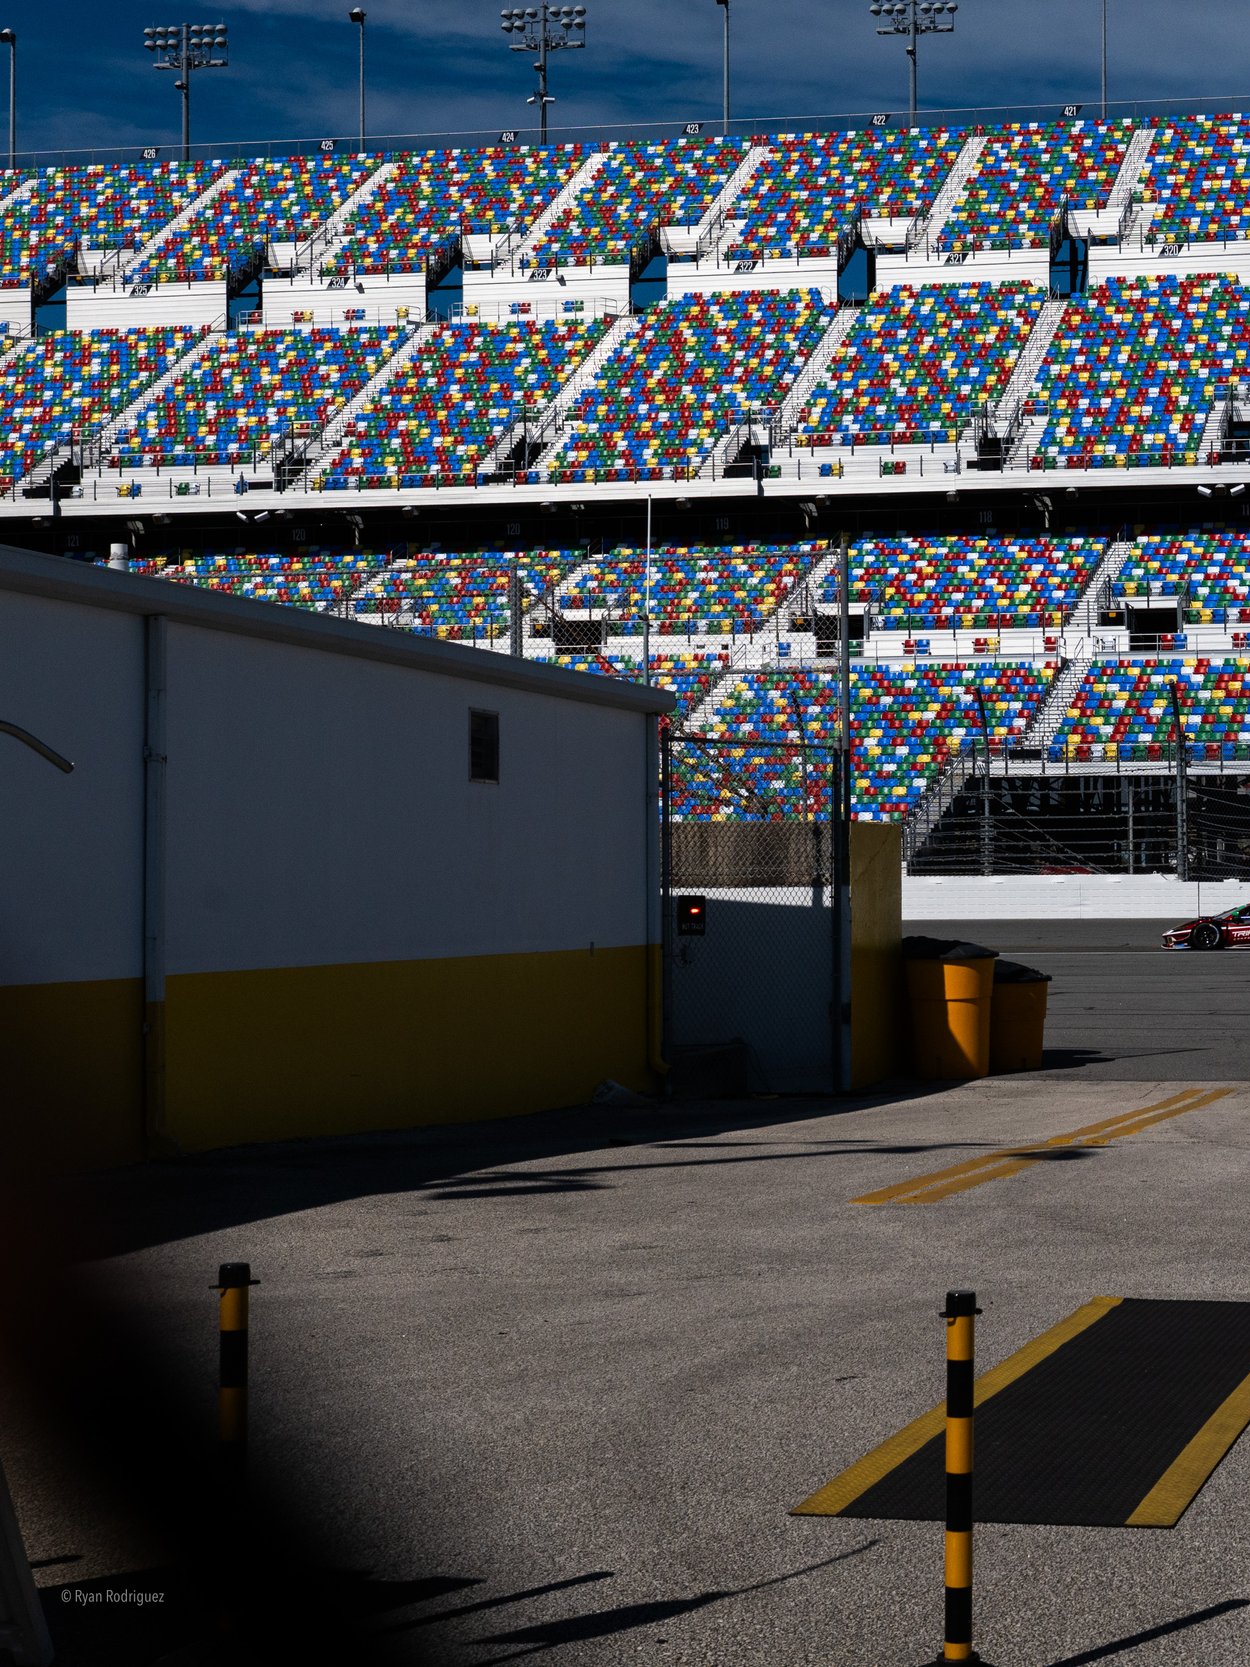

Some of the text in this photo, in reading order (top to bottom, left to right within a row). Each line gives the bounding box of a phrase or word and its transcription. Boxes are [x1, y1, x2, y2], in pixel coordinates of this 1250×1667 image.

[1064, 106, 1076, 116] 421
[873, 116, 885, 125] 422
[686, 124, 699, 134] 423
[502, 133, 514, 142] 424
[321, 141, 333, 150] 425
[143, 149, 156, 158] 426
[1164, 245, 1179, 255] 320
[949, 253, 963, 263] 321
[739, 262, 753, 272] 322
[533, 269, 547, 280] 323
[332, 277, 345, 288] 324
[134, 286, 147, 296] 325
[979, 510, 992, 523] 118
[507, 523, 521, 535] 120
[292, 529, 306, 541] 120
[67, 535, 80, 547] 121
